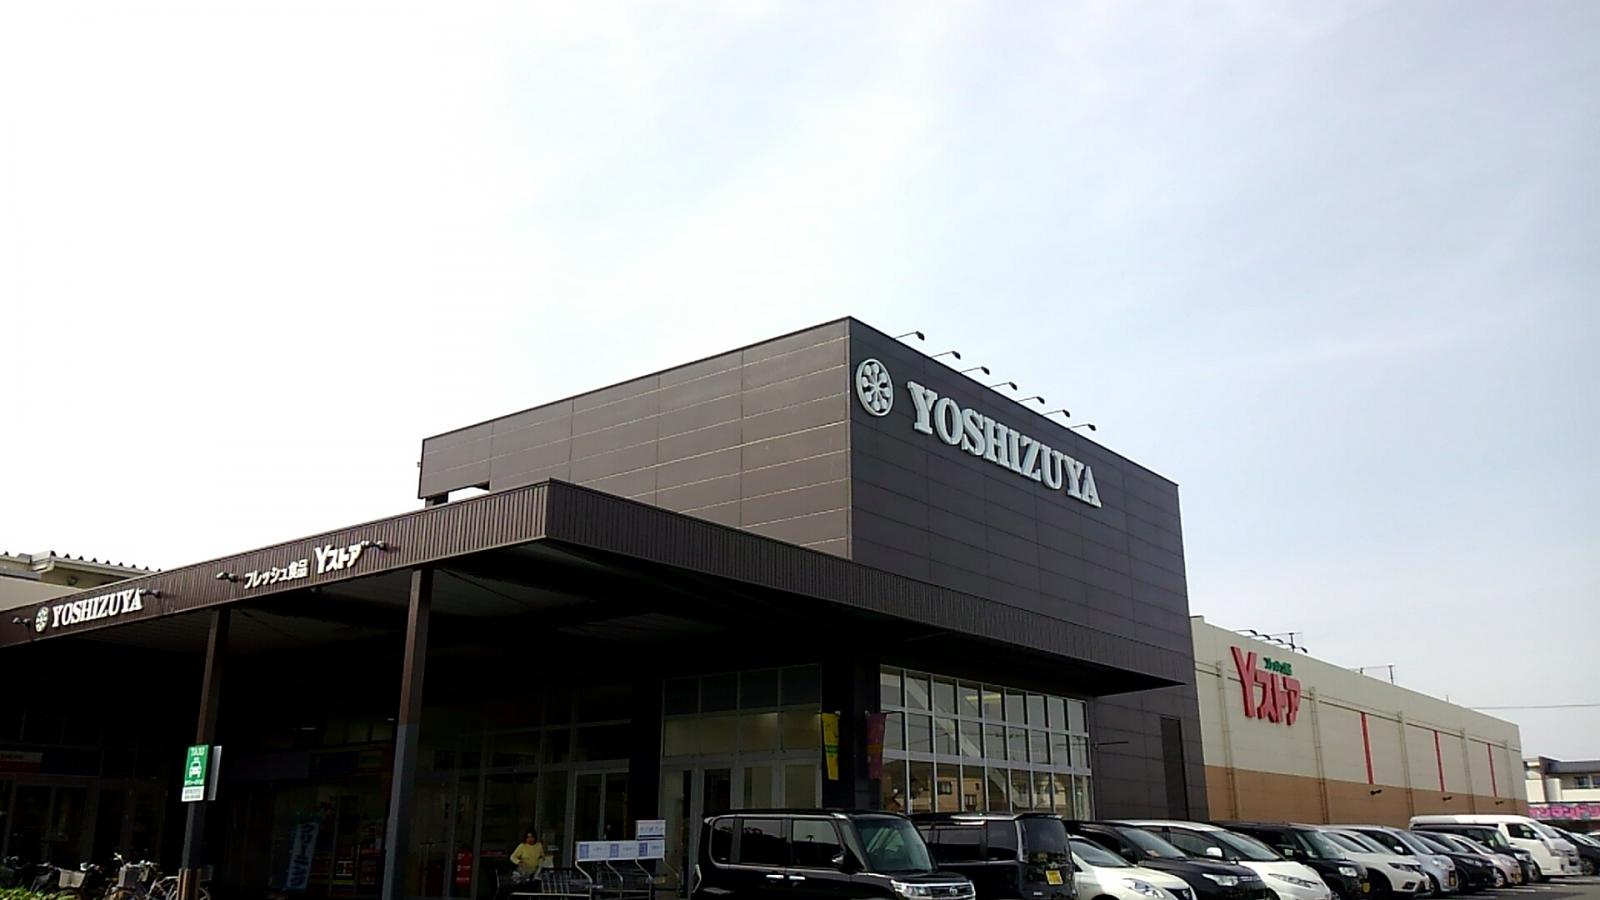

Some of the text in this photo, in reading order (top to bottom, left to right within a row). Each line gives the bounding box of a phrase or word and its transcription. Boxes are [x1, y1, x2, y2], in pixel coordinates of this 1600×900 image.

[907, 380, 1102, 508] YOSHIZUYA
[244, 544, 363, 589] フレッシュ食品 Yストア
[51, 587, 143, 628] YOSHIZUYA
[1230, 646, 1301, 726] Yストア
